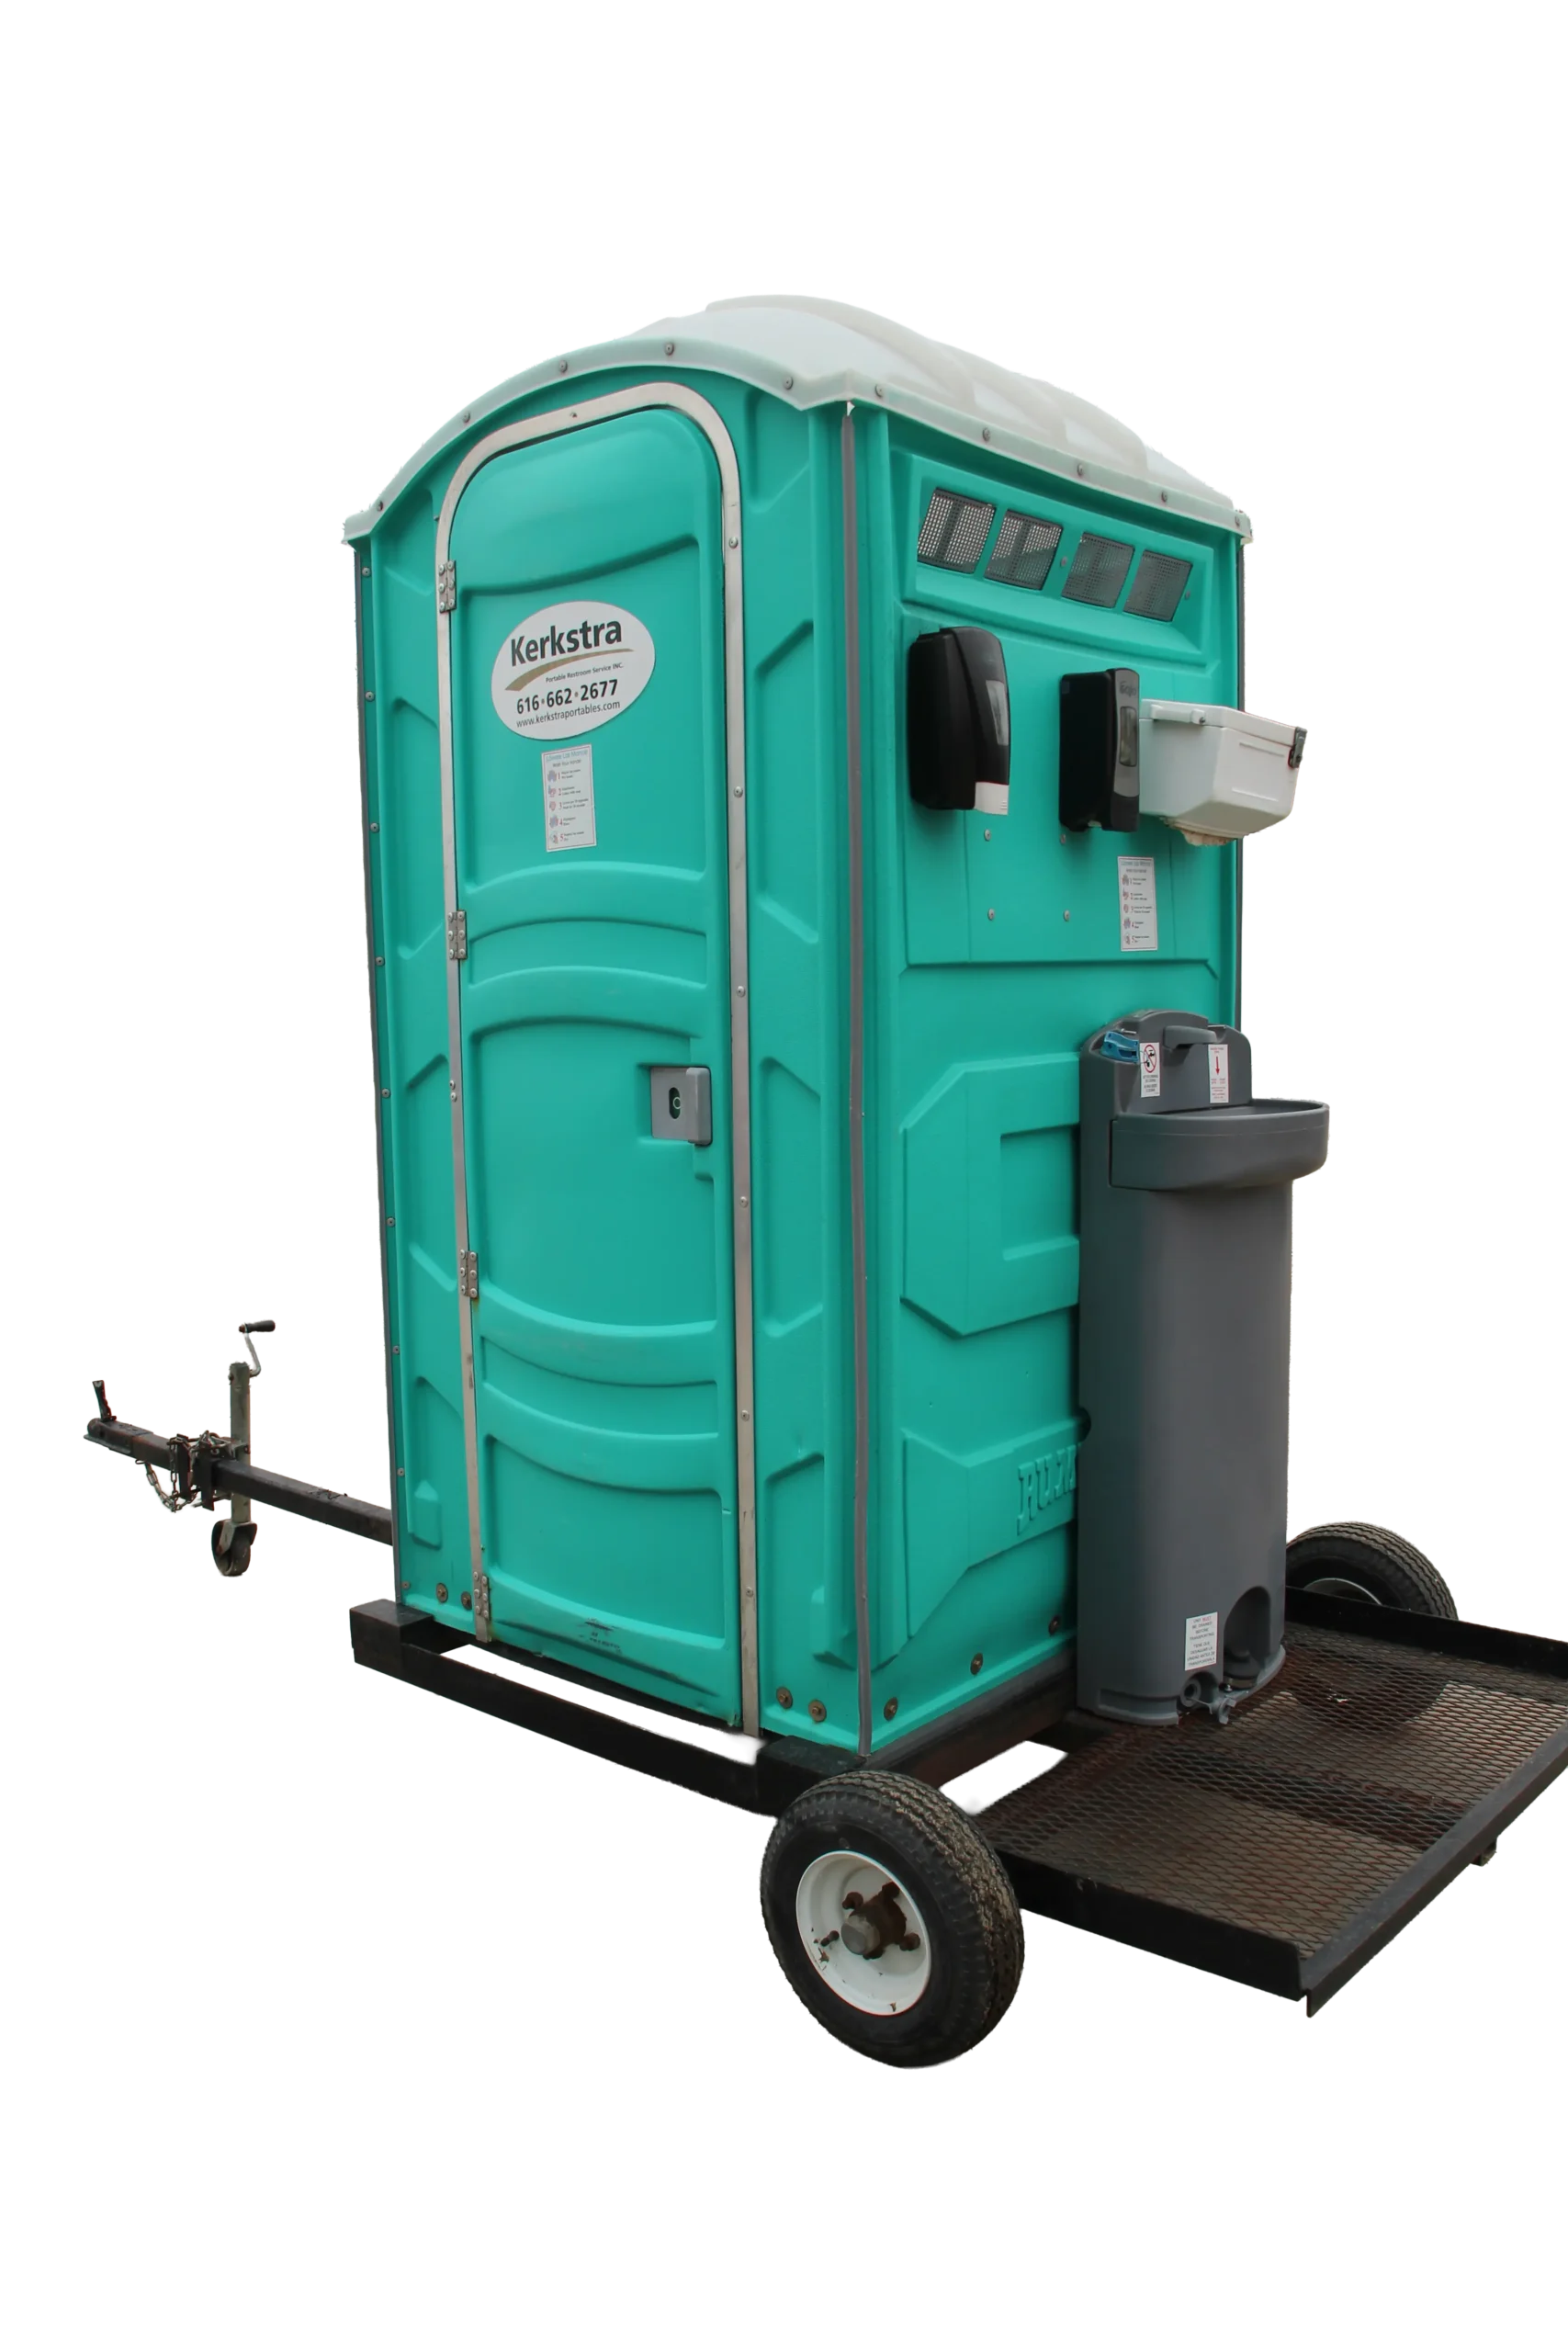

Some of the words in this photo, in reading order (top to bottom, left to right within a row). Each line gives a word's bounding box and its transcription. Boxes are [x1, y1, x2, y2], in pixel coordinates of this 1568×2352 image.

[511, 619, 623, 667] Kerkstra
[545, 673, 566, 684] Portable
[567, 669, 592, 679] Restroom
[592, 665, 611, 674] Service
[515, 701, 621, 728] www.kerkstraportables.com
